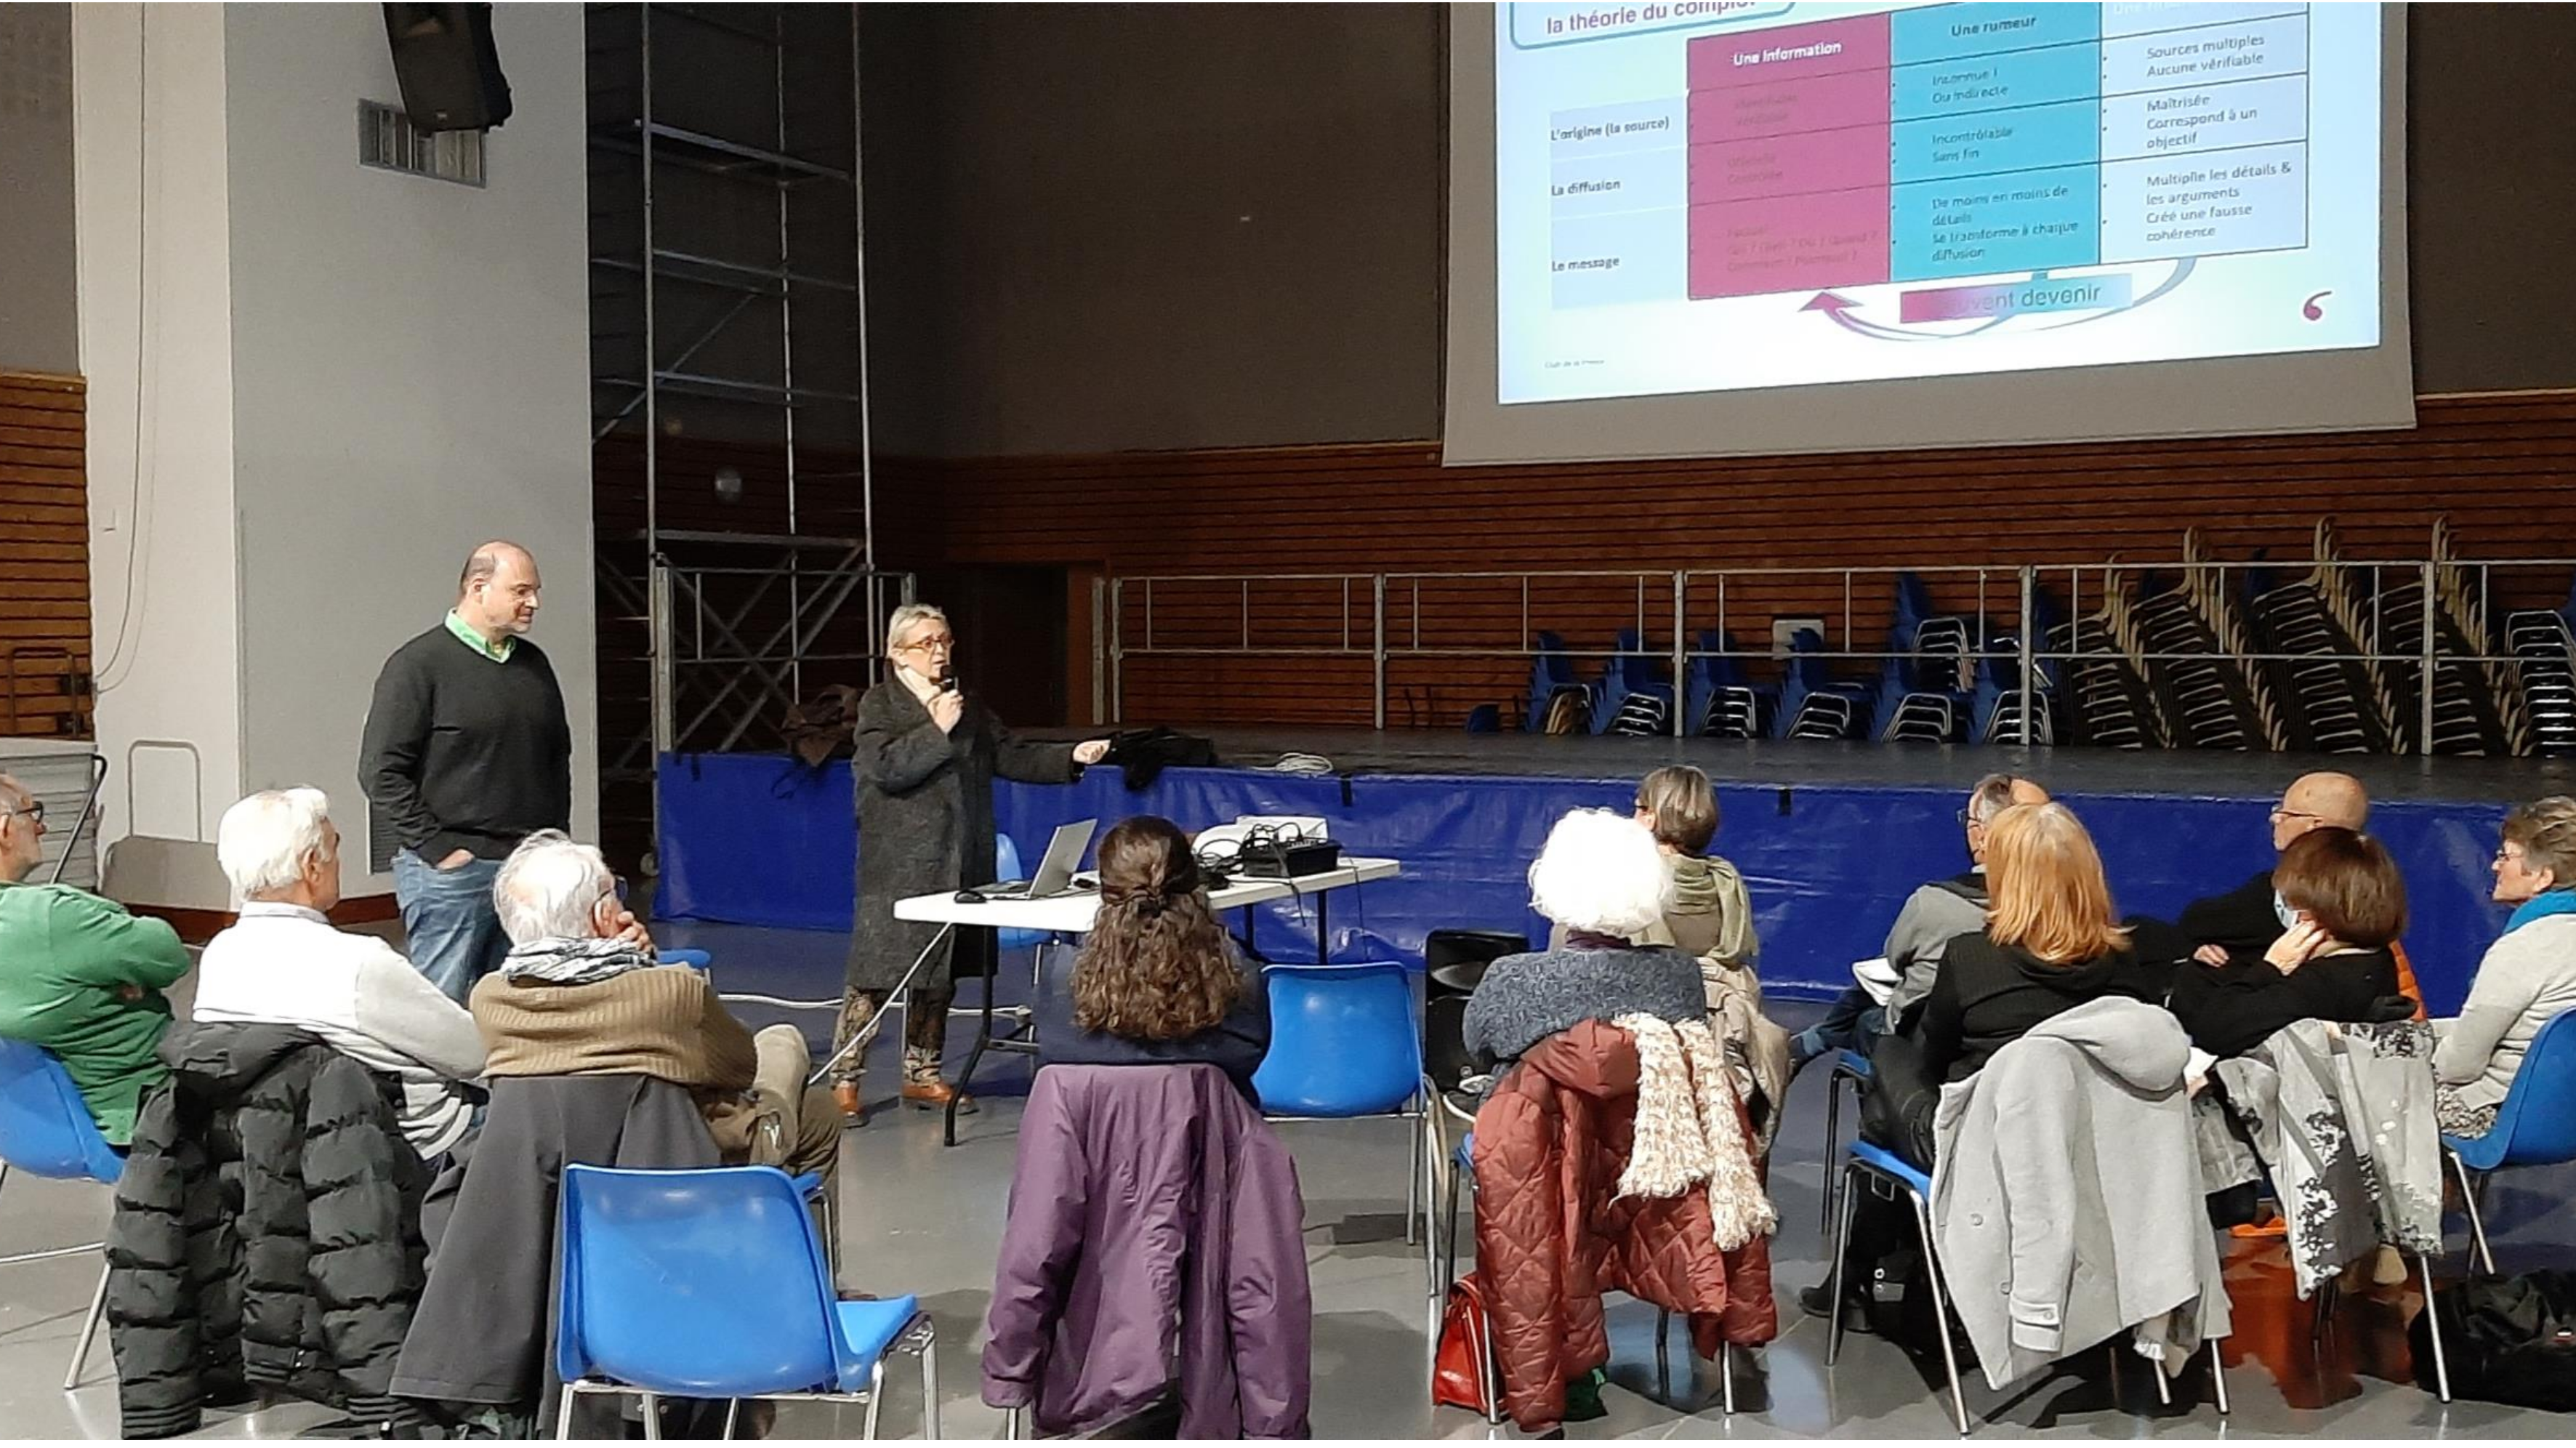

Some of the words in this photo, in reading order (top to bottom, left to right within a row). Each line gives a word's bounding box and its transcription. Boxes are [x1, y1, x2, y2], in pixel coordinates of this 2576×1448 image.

[1547, 17, 1563, 35] la
[1569, 7, 1636, 30] théorie
[1643, 3, 1667, 21] du
[1674, 2, 1755, 15] comp
[1951, 23, 1980, 38] Une
[1983, 17, 2037, 33] rumeur
[2147, 44, 2199, 59] Sources
[2203, 35, 2265, 54] multiples
[1734, 52, 1759, 65] Une
[2147, 63, 2197, 77] Aucune
[2201, 53, 2264, 71] vérifiable
[1933, 92, 1951, 103] Ou
[2147, 96, 2210, 112] Maîtrisée
[1606, 122, 1621, 137] (la
[1625, 116, 1669, 131] source)
[2147, 112, 2225, 129] Correspond
[2229, 110, 2237, 121] à
[2240, 108, 2258, 119] un
[2147, 132, 2197, 150] objectif
[1933, 151, 1959, 162] Sans
[1963, 148, 1979, 160] fin
[2210, 169, 2227, 182] les
[2231, 165, 2277, 180] détails
[1551, 185, 1564, 196] La
[1568, 180, 1621, 194] diffusion
[2011, 188, 2050, 201] moins
[2053, 185, 2069, 198] de
[2147, 194, 2164, 206] les
[2168, 186, 2240, 204] arguments
[2181, 209, 2206, 221] une
[2210, 204, 2252, 219] fausse
[2147, 226, 2215, 242] cohérence
[1552, 261, 1564, 272] Le
[1568, 257, 1619, 270] message
[2021, 283, 2101, 307] devenir
